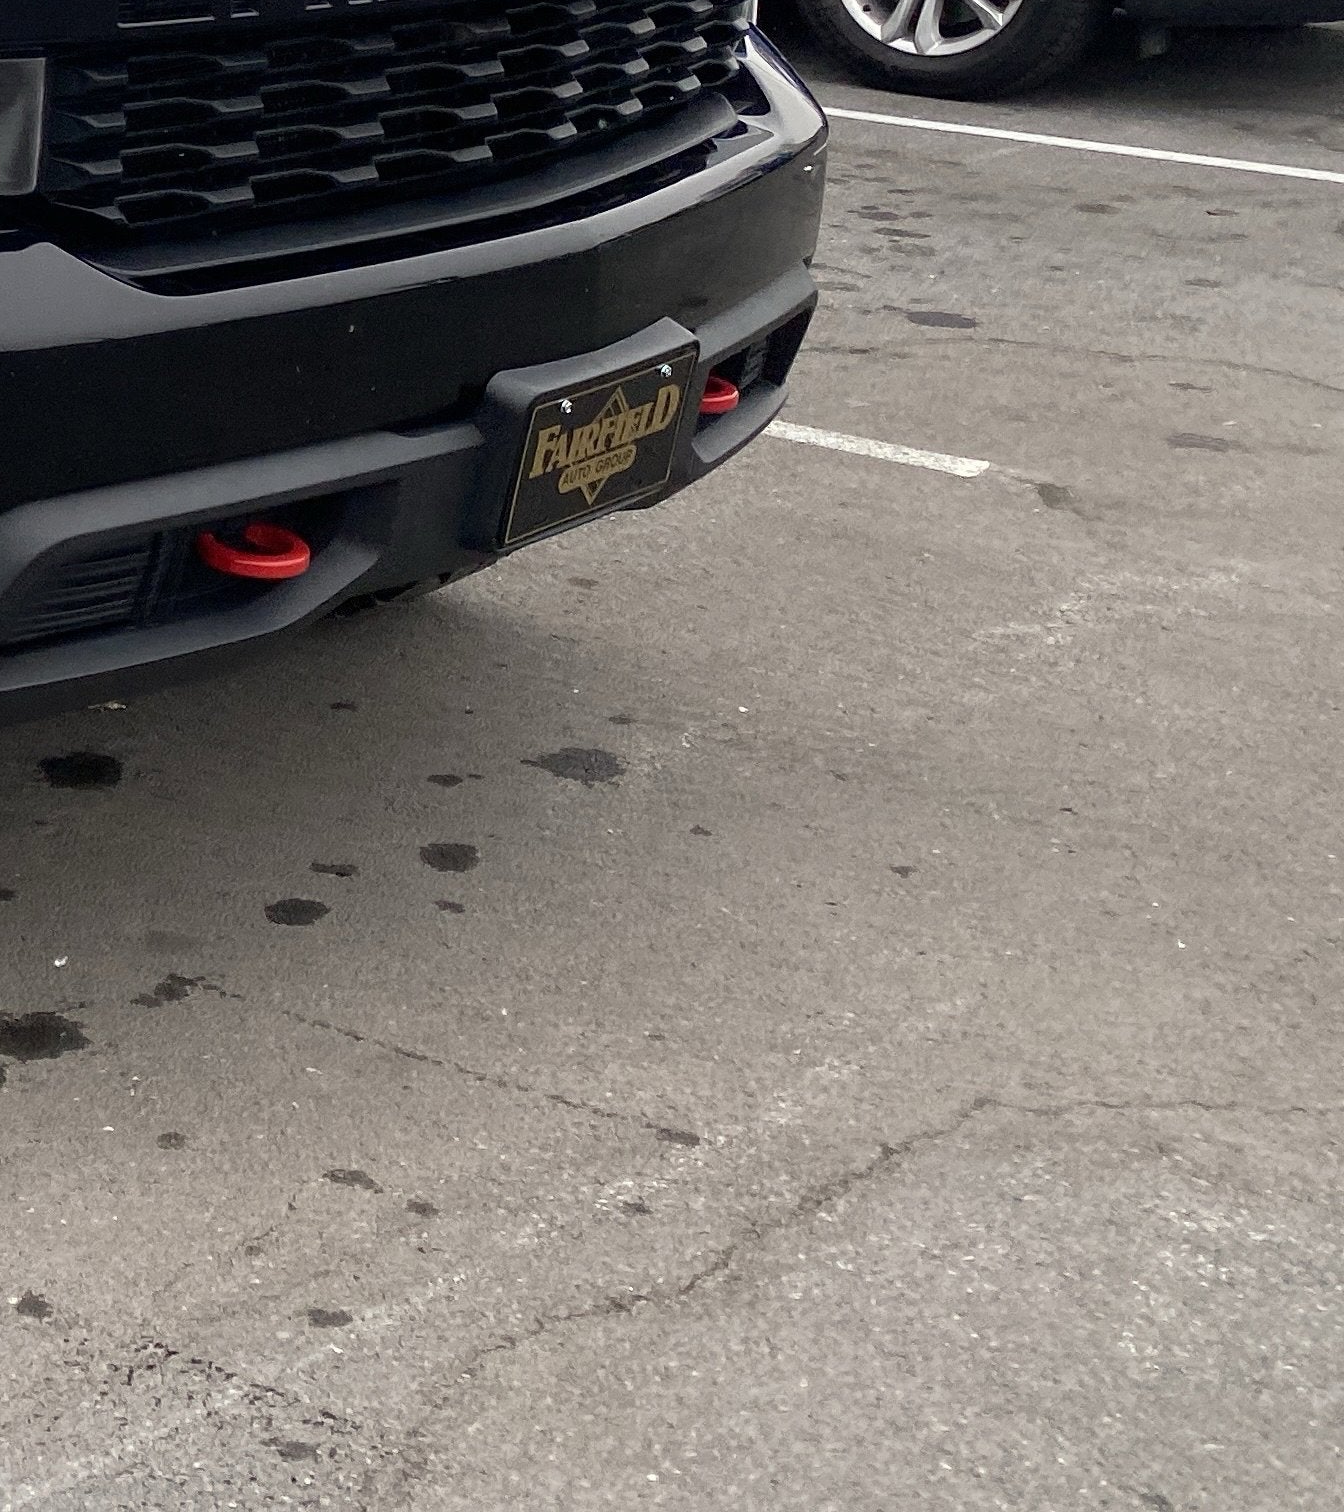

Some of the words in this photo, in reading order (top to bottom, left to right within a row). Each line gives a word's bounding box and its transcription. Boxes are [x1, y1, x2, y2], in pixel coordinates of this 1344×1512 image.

[528, 384, 682, 479] FAIRFIELD
[561, 464, 592, 487] AUTO
[595, 449, 636, 476] GROUP
